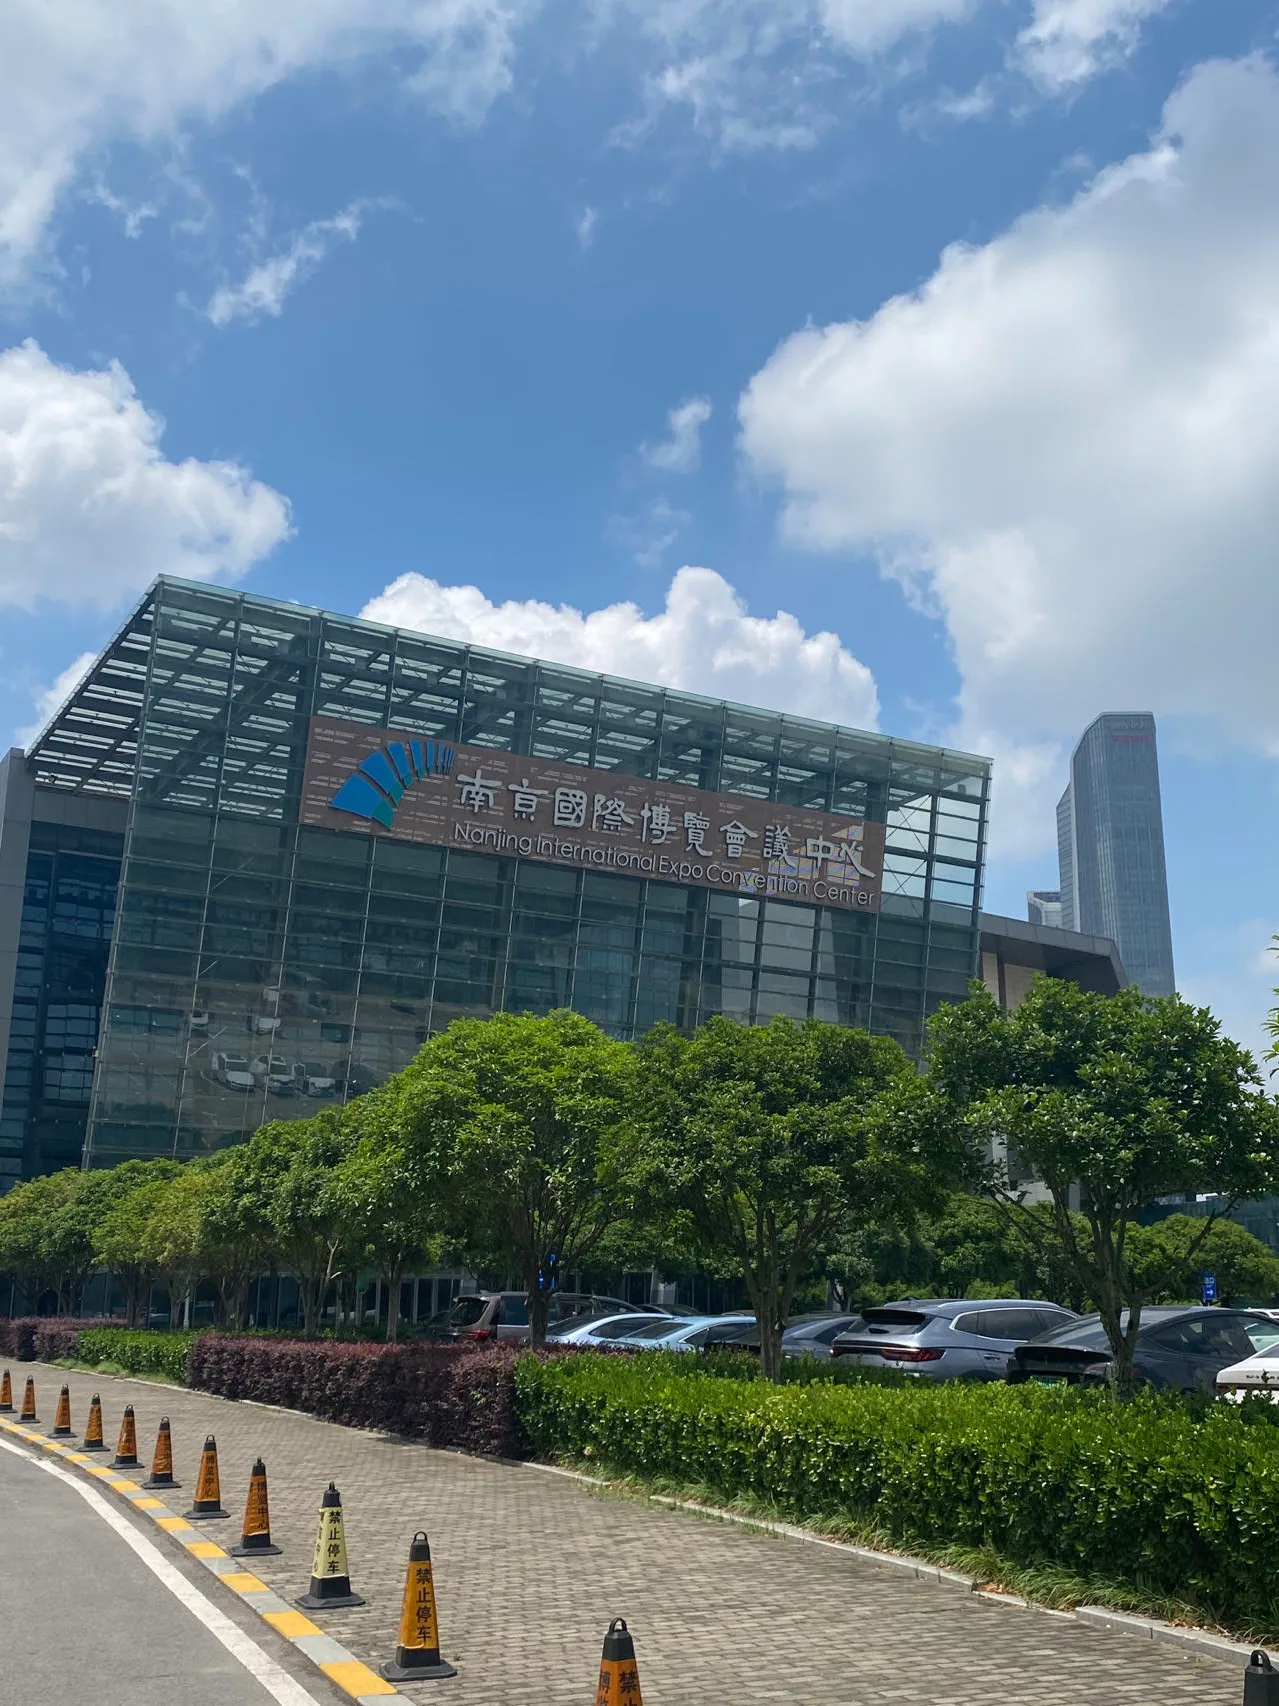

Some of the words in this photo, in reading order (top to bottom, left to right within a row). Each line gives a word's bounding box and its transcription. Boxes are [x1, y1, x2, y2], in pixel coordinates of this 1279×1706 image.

[457, 769, 876, 878] 南京國際博覽會議中心
[454, 822, 532, 855] Nanjing
[536, 834, 656, 872] International
[658, 855, 703, 880] Expo
[706, 864, 809, 896] Convention
[813, 881, 875, 905] Center
[327, 1510, 341, 1574] 禁止停车
[416, 1567, 432, 1643] 禁止停车
